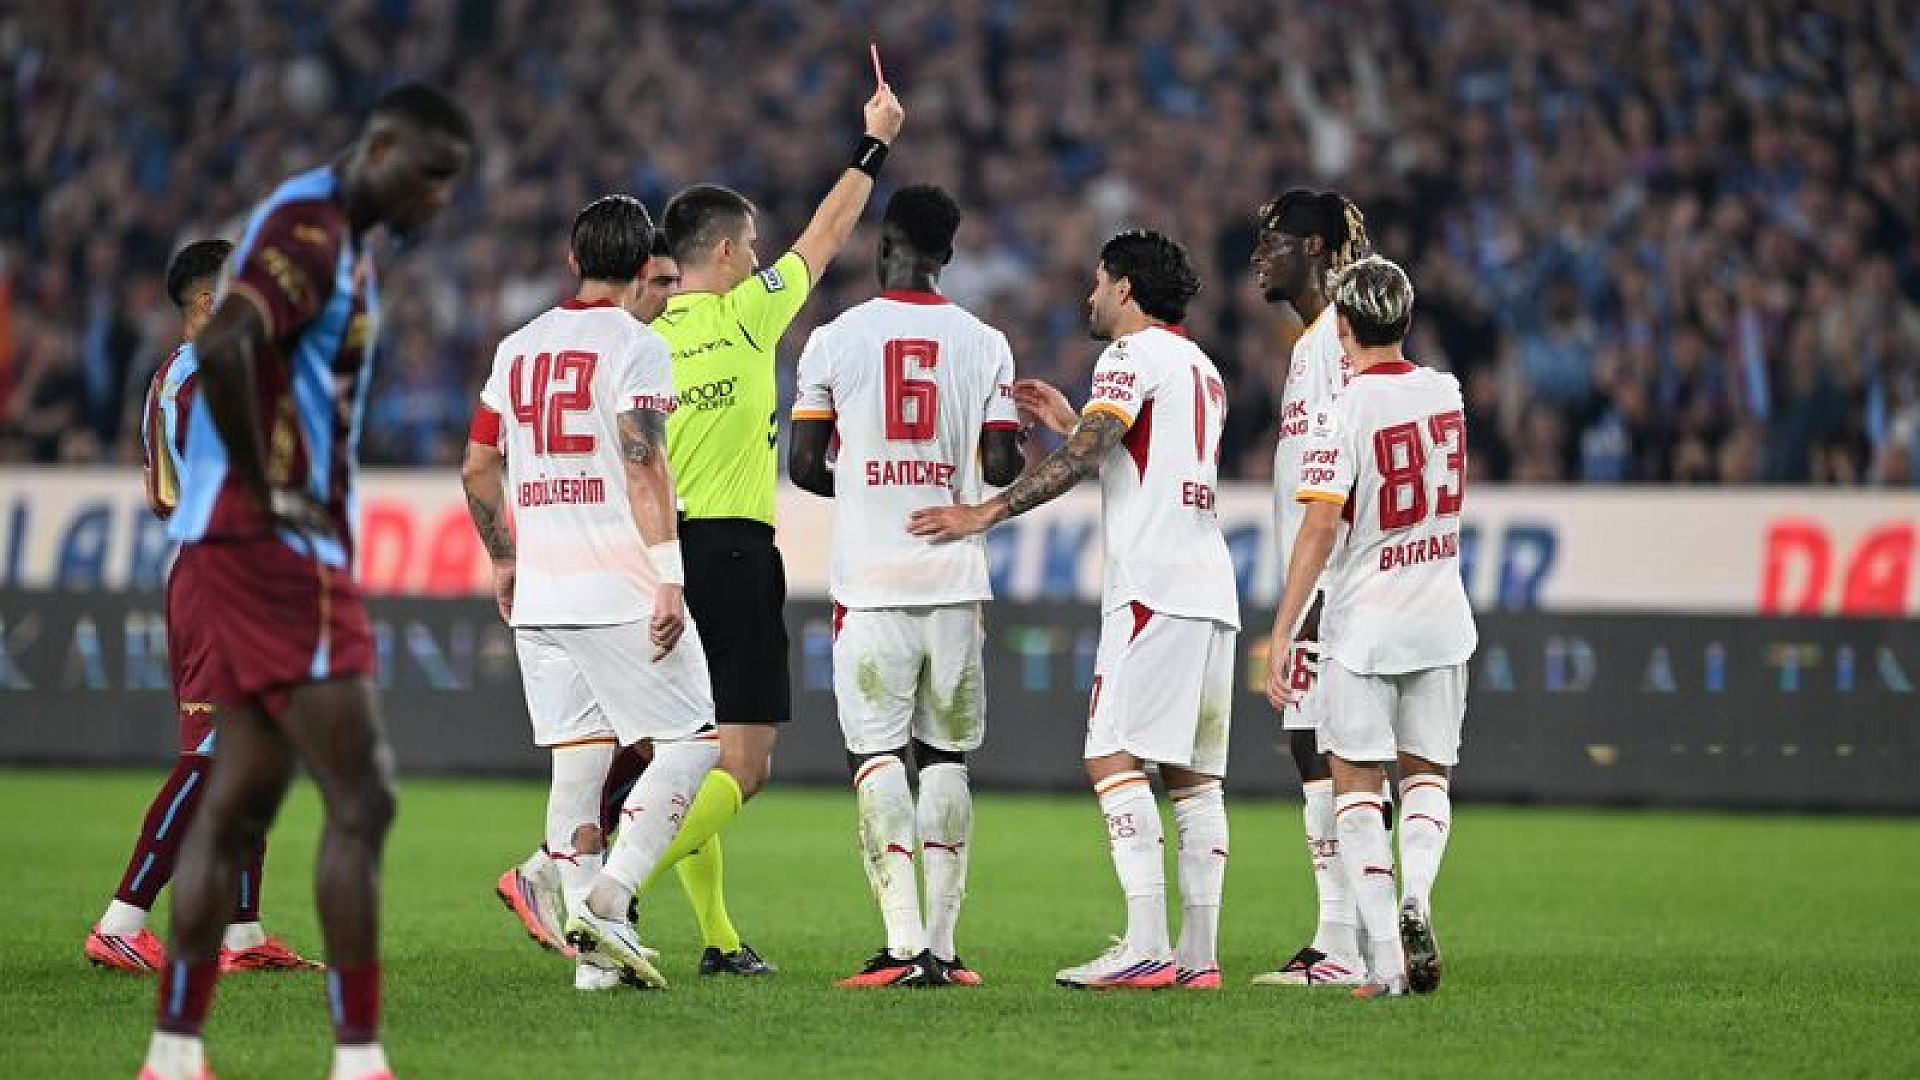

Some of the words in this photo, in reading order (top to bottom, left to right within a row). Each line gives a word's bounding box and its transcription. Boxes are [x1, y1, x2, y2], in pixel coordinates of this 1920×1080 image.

[509, 351, 598, 456] 42
[885, 340, 938, 441] 6
[1374, 410, 1464, 531] 83
